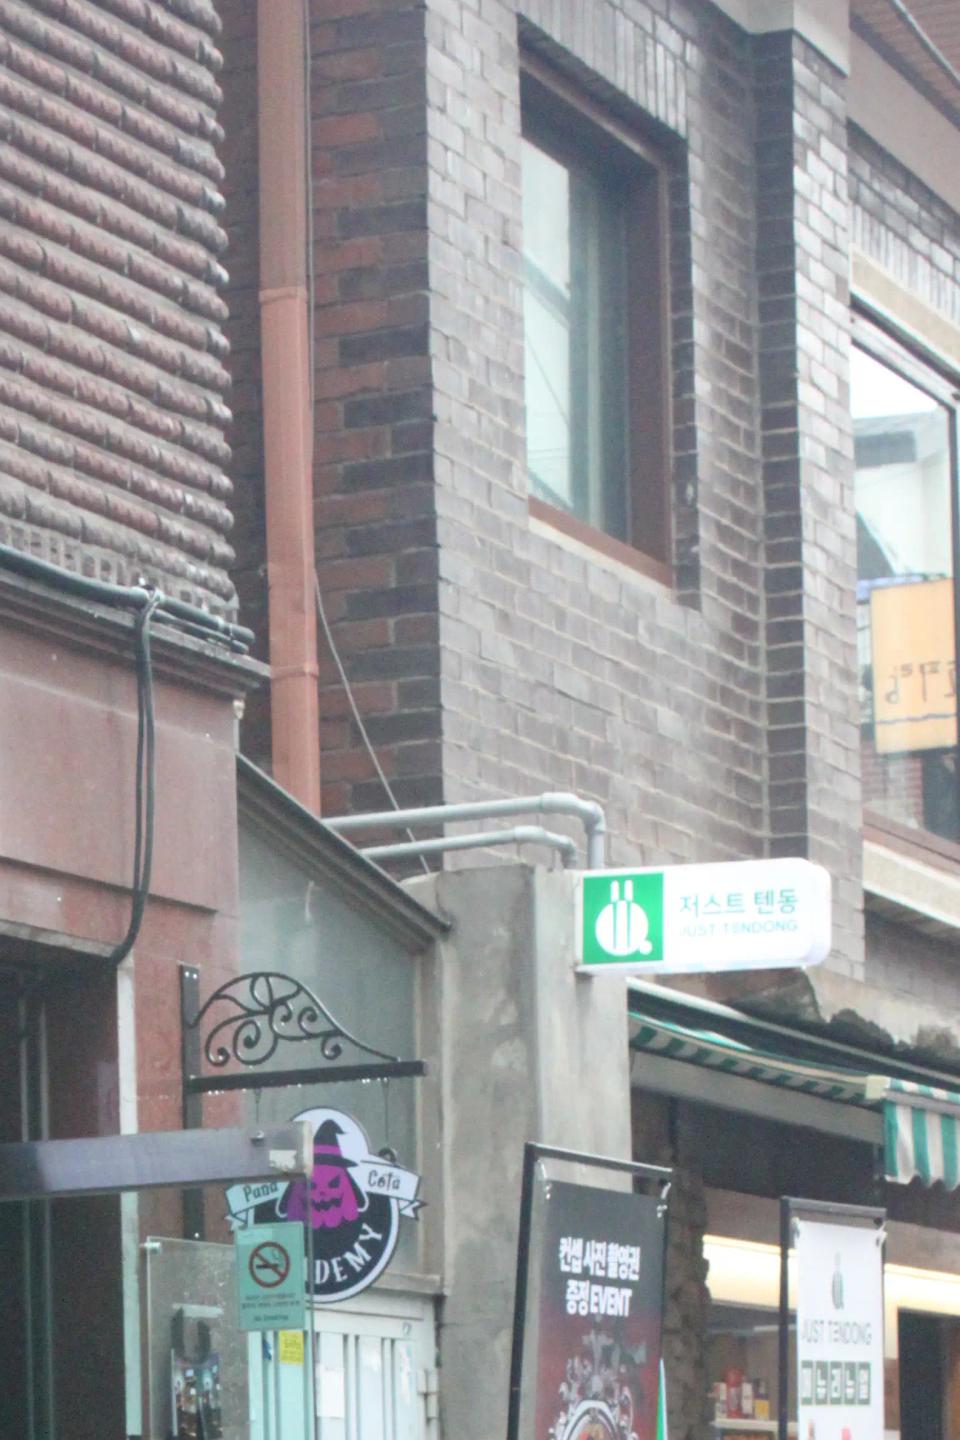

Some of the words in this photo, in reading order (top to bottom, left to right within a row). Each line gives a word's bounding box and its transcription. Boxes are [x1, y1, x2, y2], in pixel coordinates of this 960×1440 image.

[679, 892, 746, 919] 저스트
[753, 888, 799, 915] 텐동
[590, 1284, 633, 1318] EVENT
